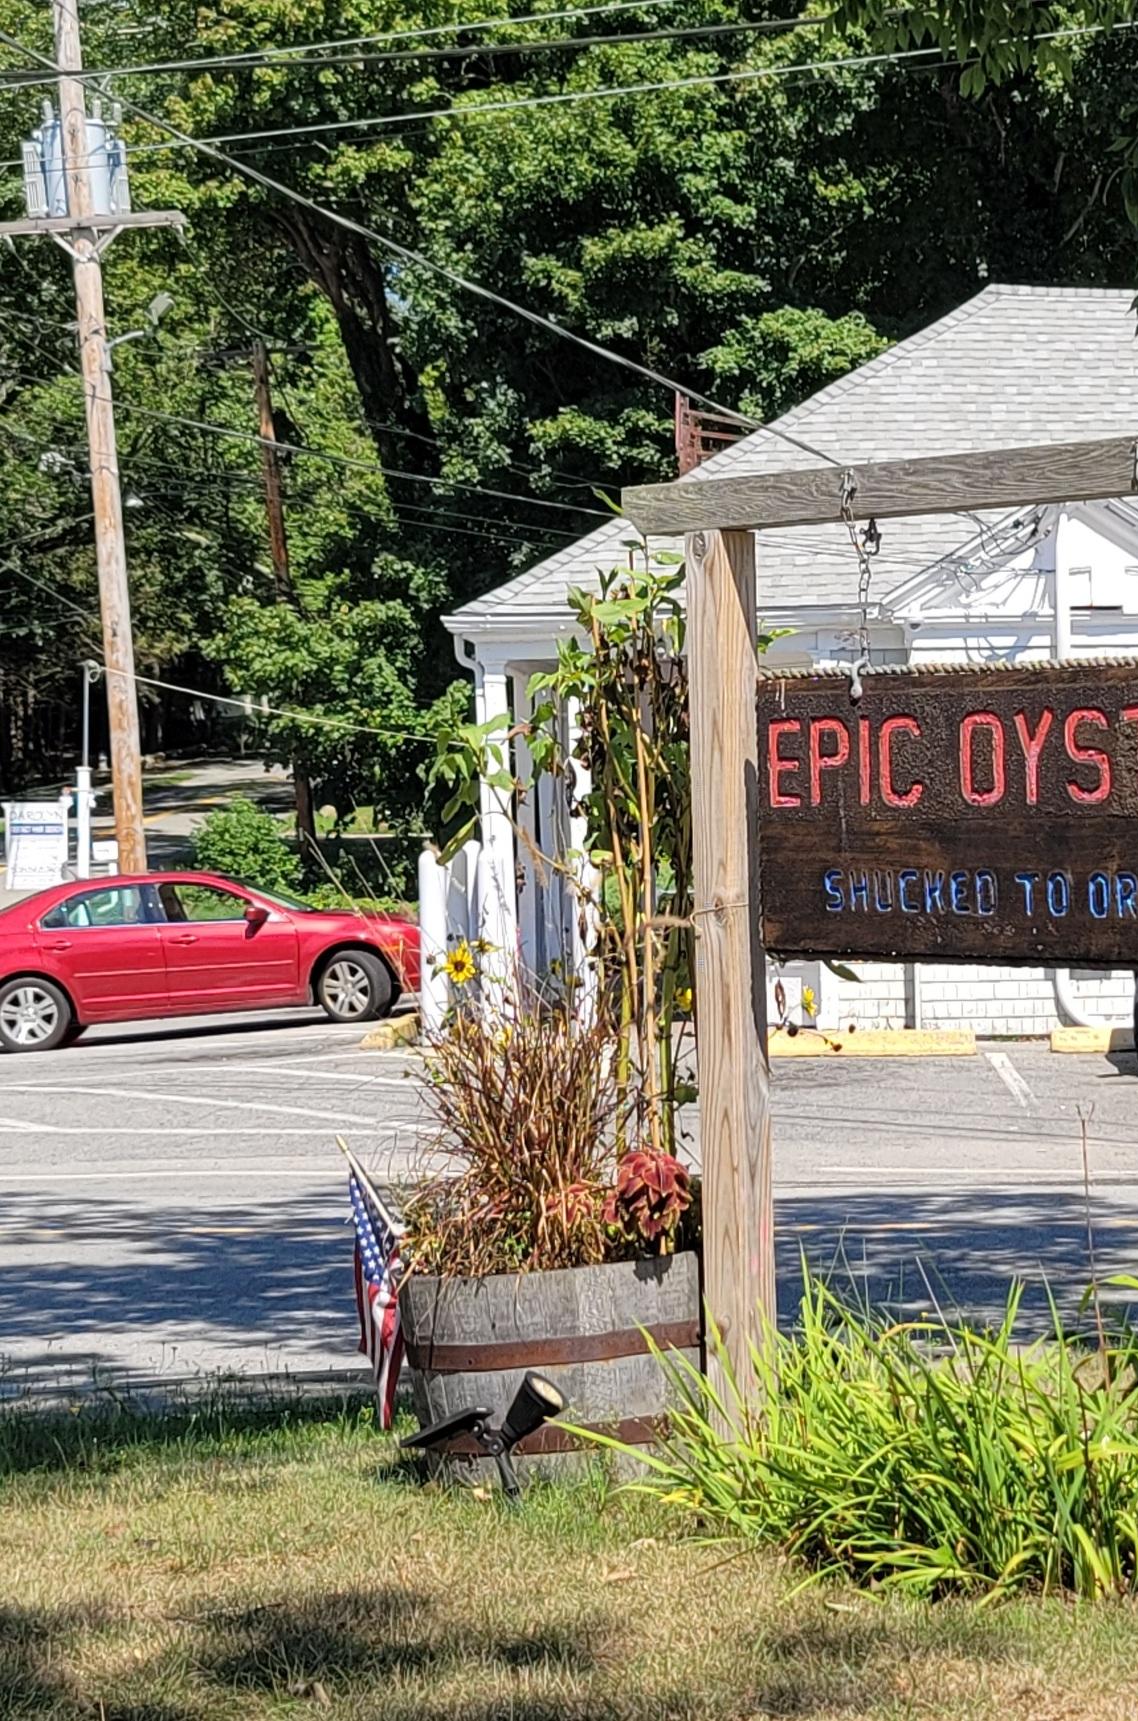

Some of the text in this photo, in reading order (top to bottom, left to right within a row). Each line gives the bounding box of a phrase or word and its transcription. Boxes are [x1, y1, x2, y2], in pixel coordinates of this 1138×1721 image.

[767, 716, 924, 808] EPIC
[823, 868, 998, 916] SHUCKED
[1016, 871, 1070, 918] TO
